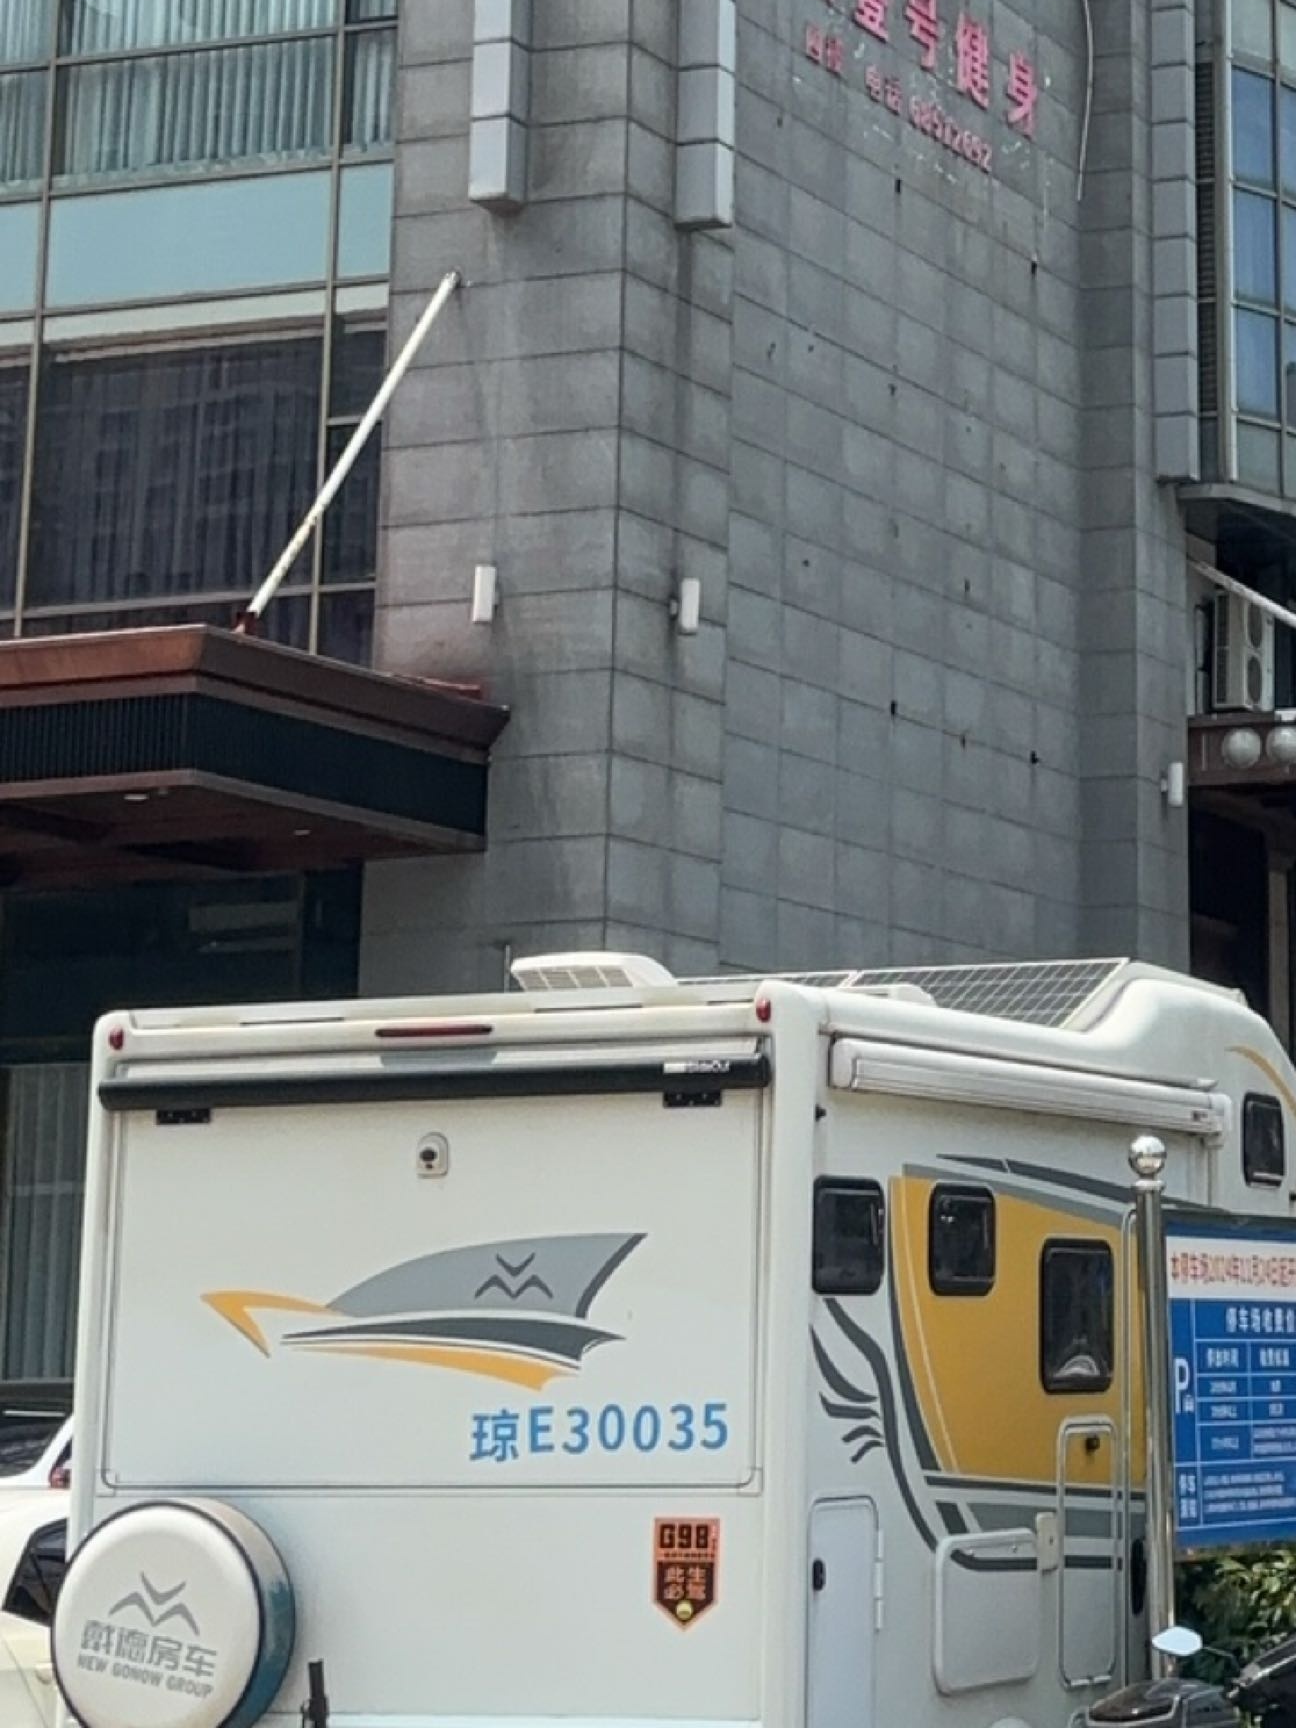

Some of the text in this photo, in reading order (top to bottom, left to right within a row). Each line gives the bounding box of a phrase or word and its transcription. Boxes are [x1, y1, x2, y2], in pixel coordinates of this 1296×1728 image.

[470, 1402, 729, 1463] 琼E30035
[659, 1523, 708, 1548] G98
[166, 1674, 213, 1698] GROUP
